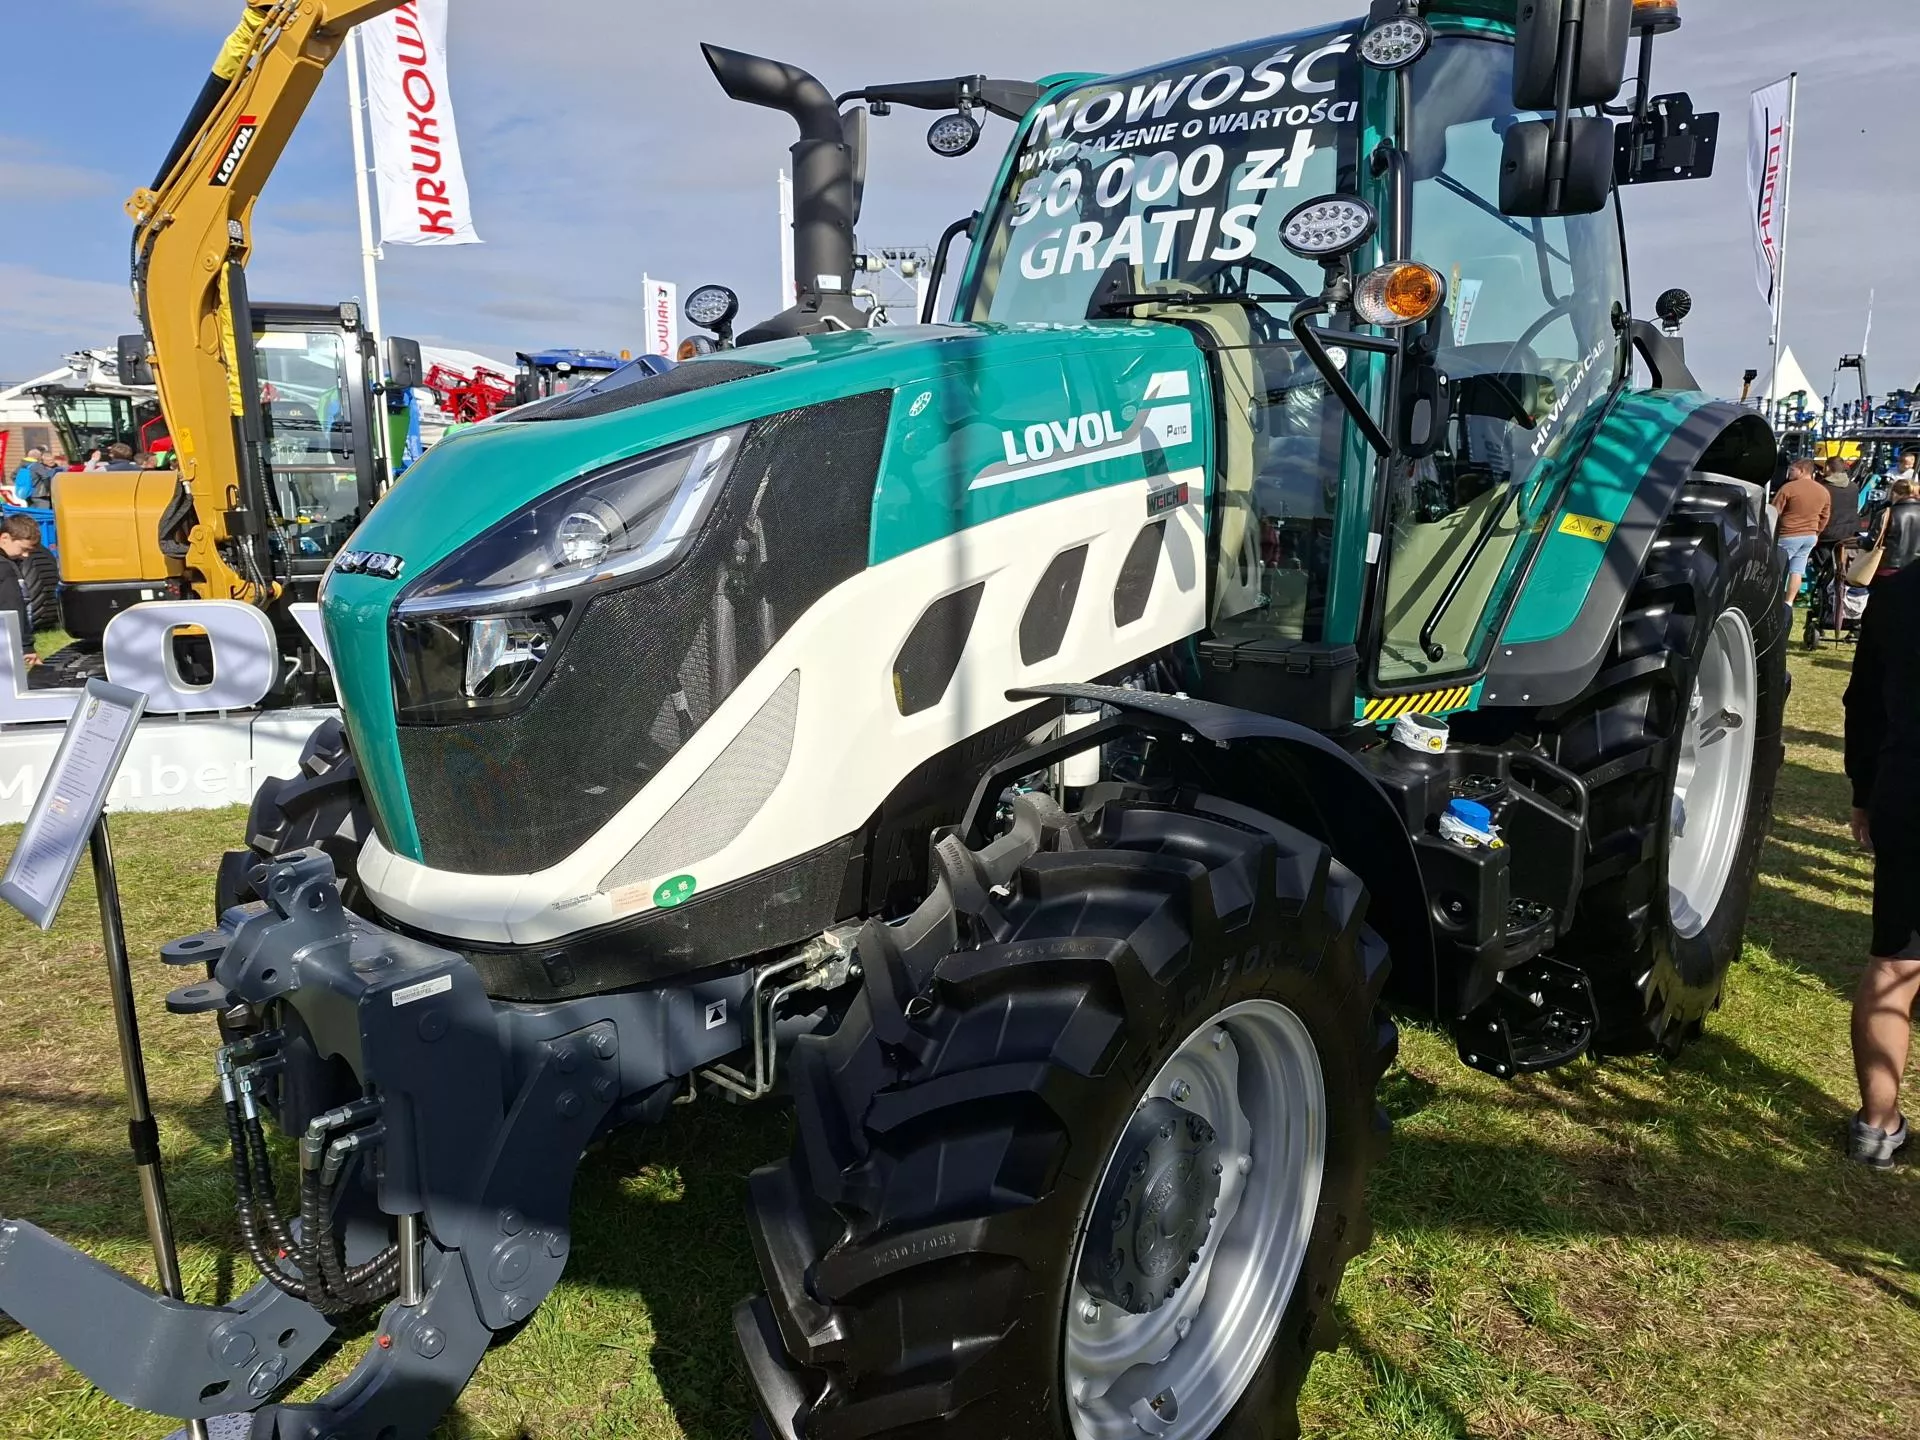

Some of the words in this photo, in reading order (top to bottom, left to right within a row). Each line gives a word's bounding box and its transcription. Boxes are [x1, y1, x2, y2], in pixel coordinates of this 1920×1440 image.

[1027, 33, 1354, 147] NOWOŚĆ
[217, 127, 253, 183] LOVOL
[1018, 122, 1179, 173] WYPOSAŻENIE
[1182, 118, 1203, 139] O
[1208, 98, 1358, 135] WARTOŚCI
[1096, 144, 1224, 209] 000
[1237, 128, 1316, 190] zł
[1020, 203, 1263, 280] GRATIS
[1583, 339, 1606, 371] CAB
[1002, 410, 1122, 466] LOVOL
